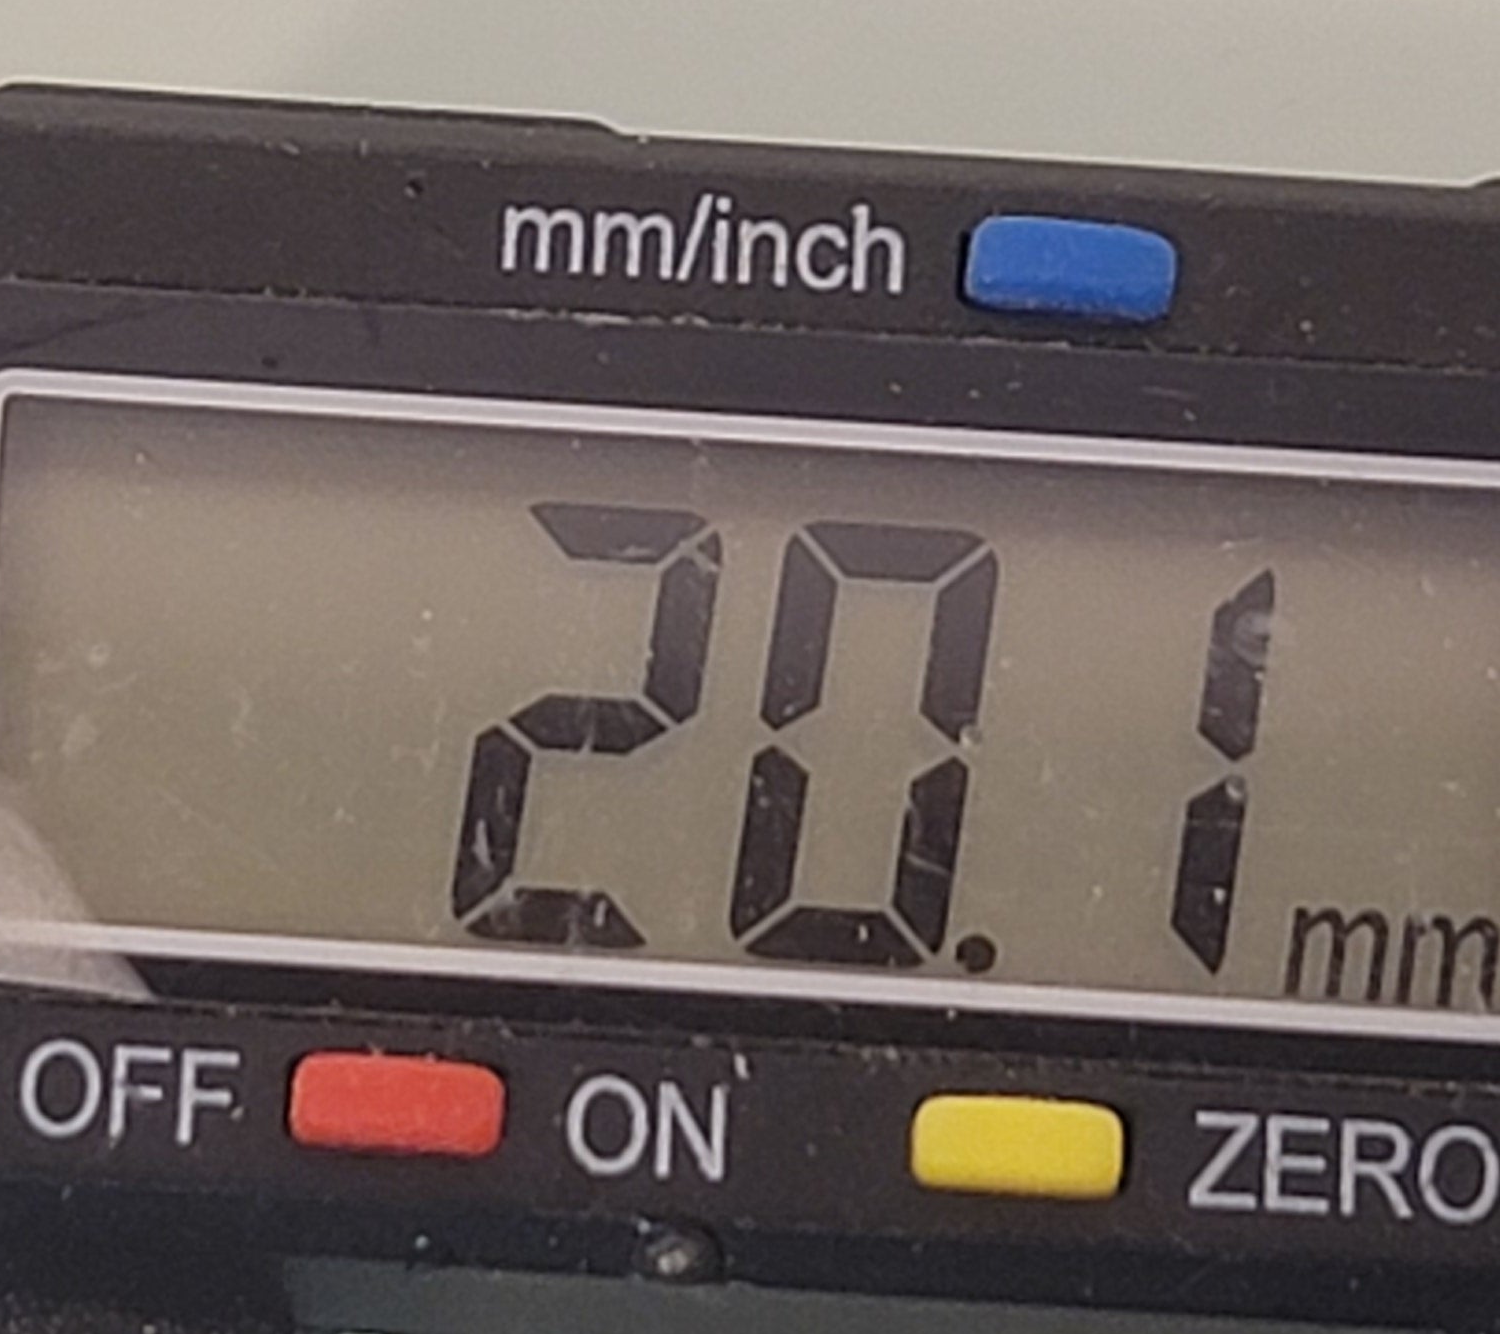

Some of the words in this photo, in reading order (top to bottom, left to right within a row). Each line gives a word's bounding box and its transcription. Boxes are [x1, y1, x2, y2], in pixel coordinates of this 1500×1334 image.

[501, 193, 905, 294] mm/inch
[452, 502, 1275, 974] 20.1
[1285, 905, 1499, 1009] mm
[19, 1037, 242, 1147] OFF
[564, 1073, 729, 1182] ON
[1187, 1109, 1499, 1225] ZERO
